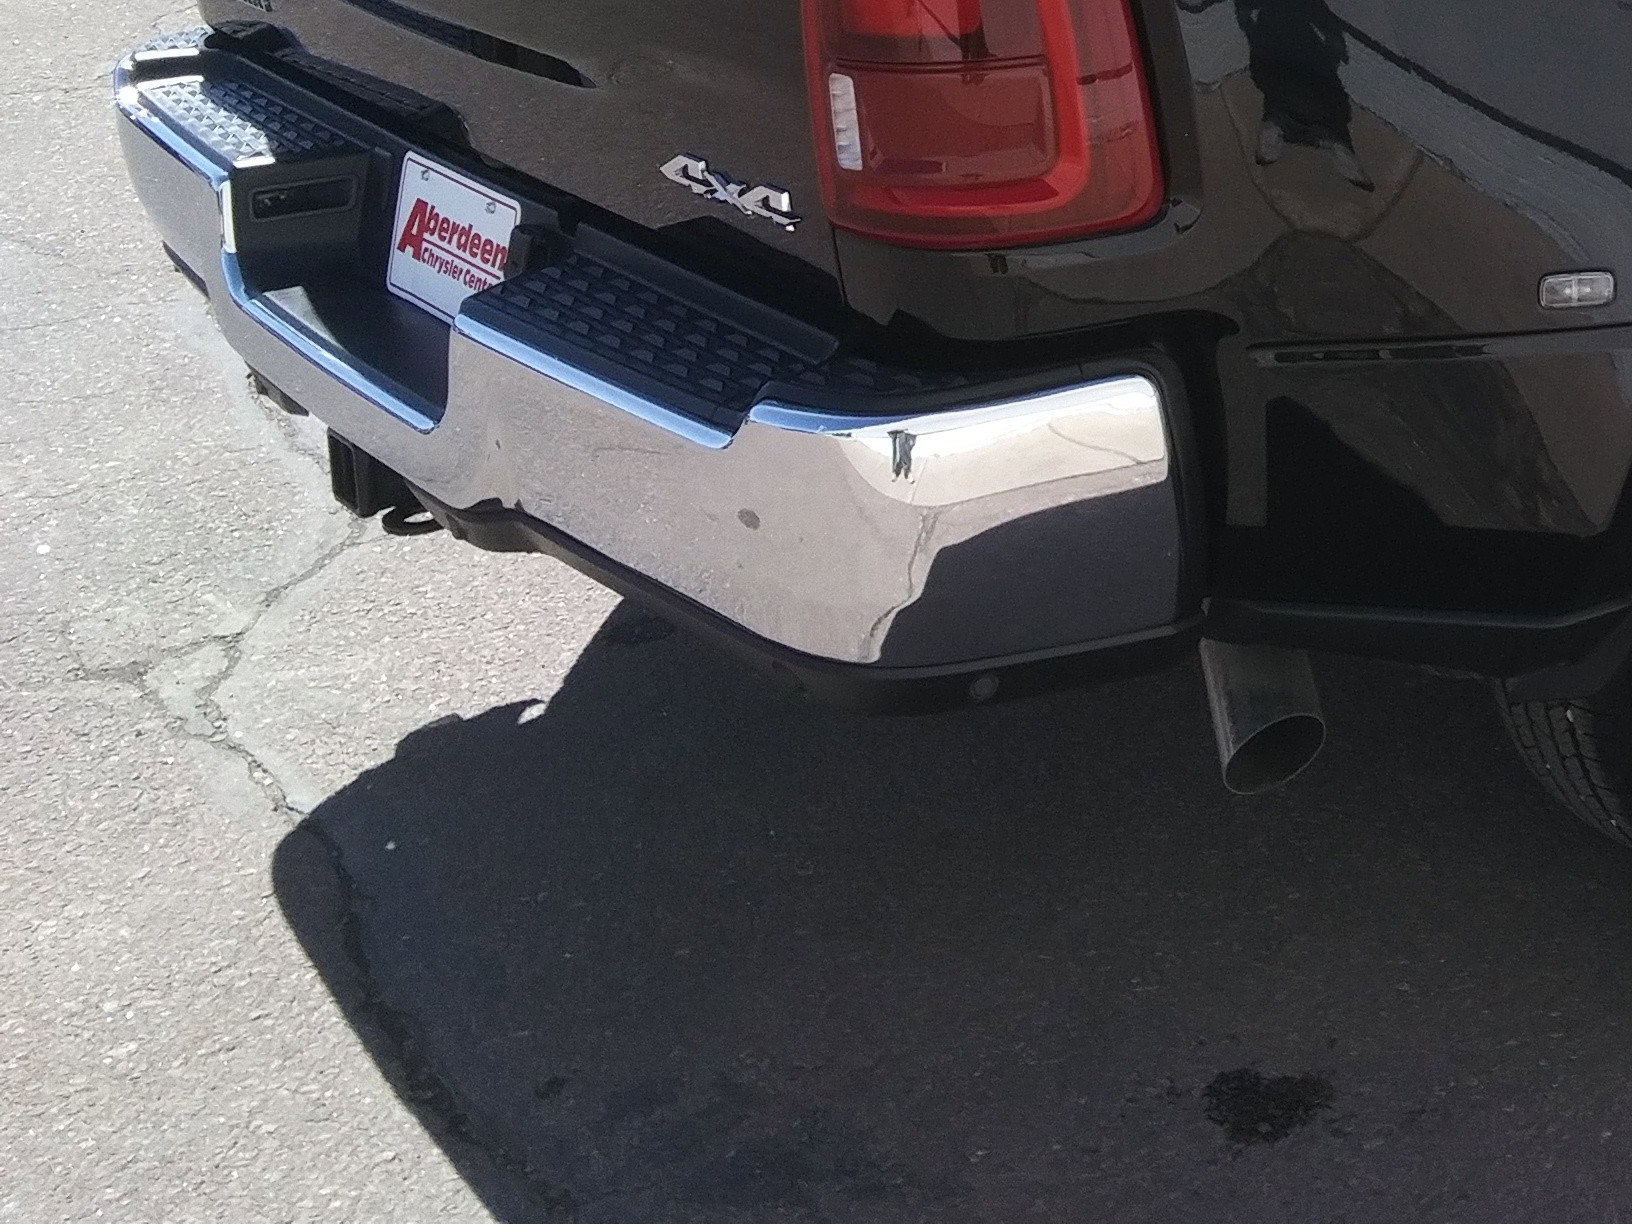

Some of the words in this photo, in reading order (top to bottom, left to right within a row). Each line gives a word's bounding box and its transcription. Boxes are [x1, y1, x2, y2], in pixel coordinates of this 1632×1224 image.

[397, 198, 508, 272] Aberdeen
[421, 246, 464, 282] Chrysler
[463, 269, 493, 292] Cent
